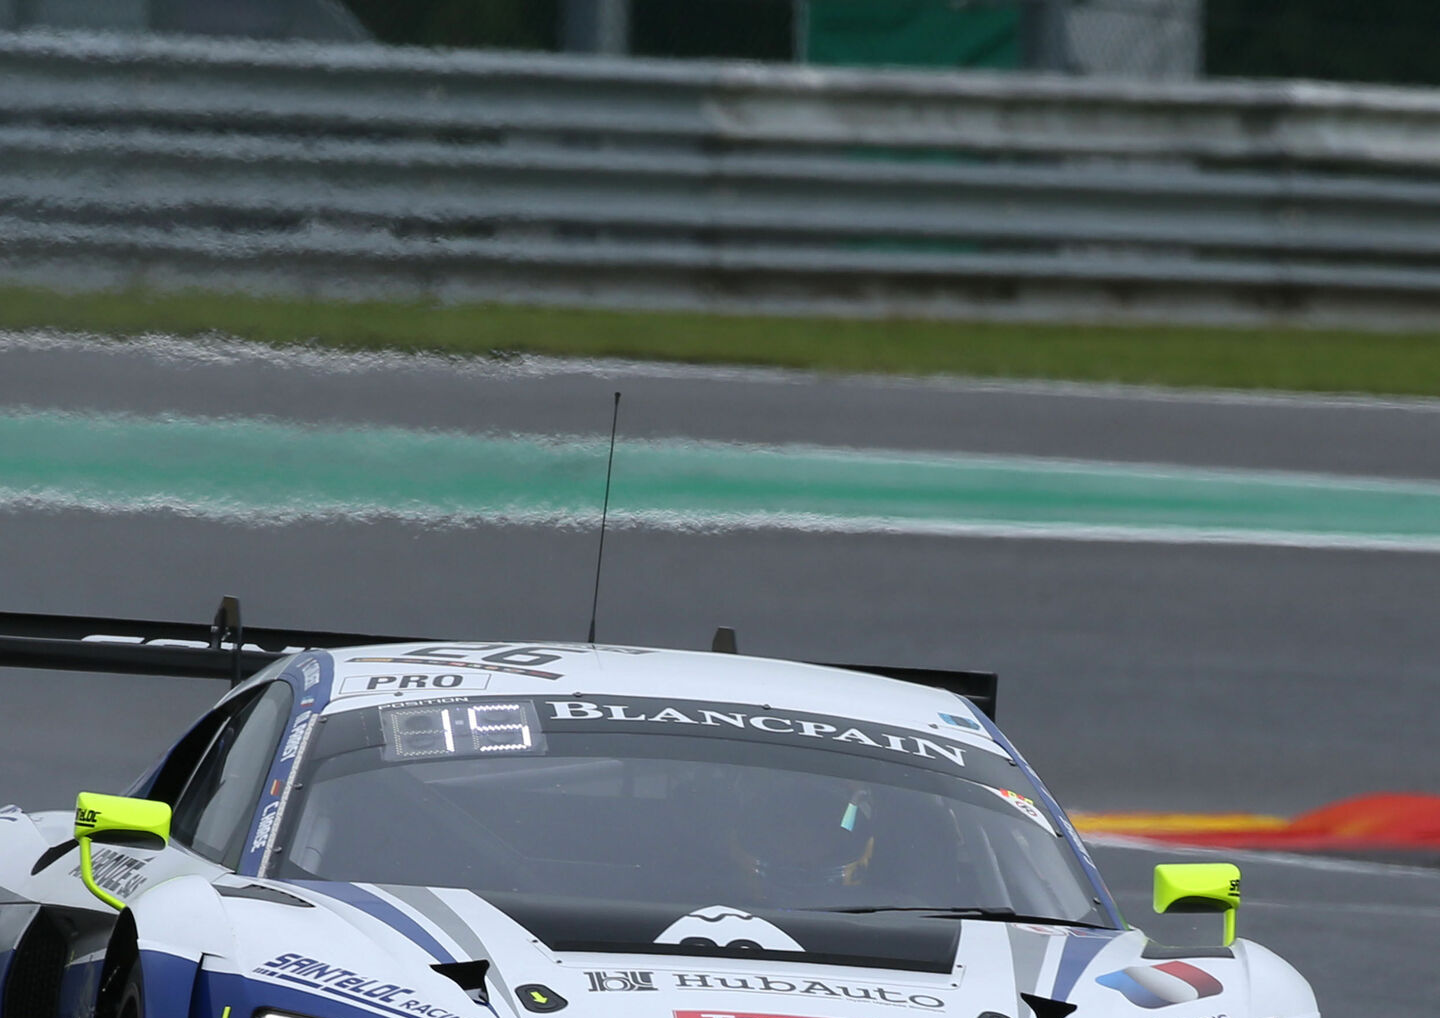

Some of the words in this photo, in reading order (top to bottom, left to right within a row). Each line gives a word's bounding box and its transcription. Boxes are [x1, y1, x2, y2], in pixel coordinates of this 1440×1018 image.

[367, 673, 464, 690] PRO
[378, 696, 470, 710] POSITION
[544, 700, 967, 768] BLANCPAIN
[672, 973, 946, 1010] HubAuto
